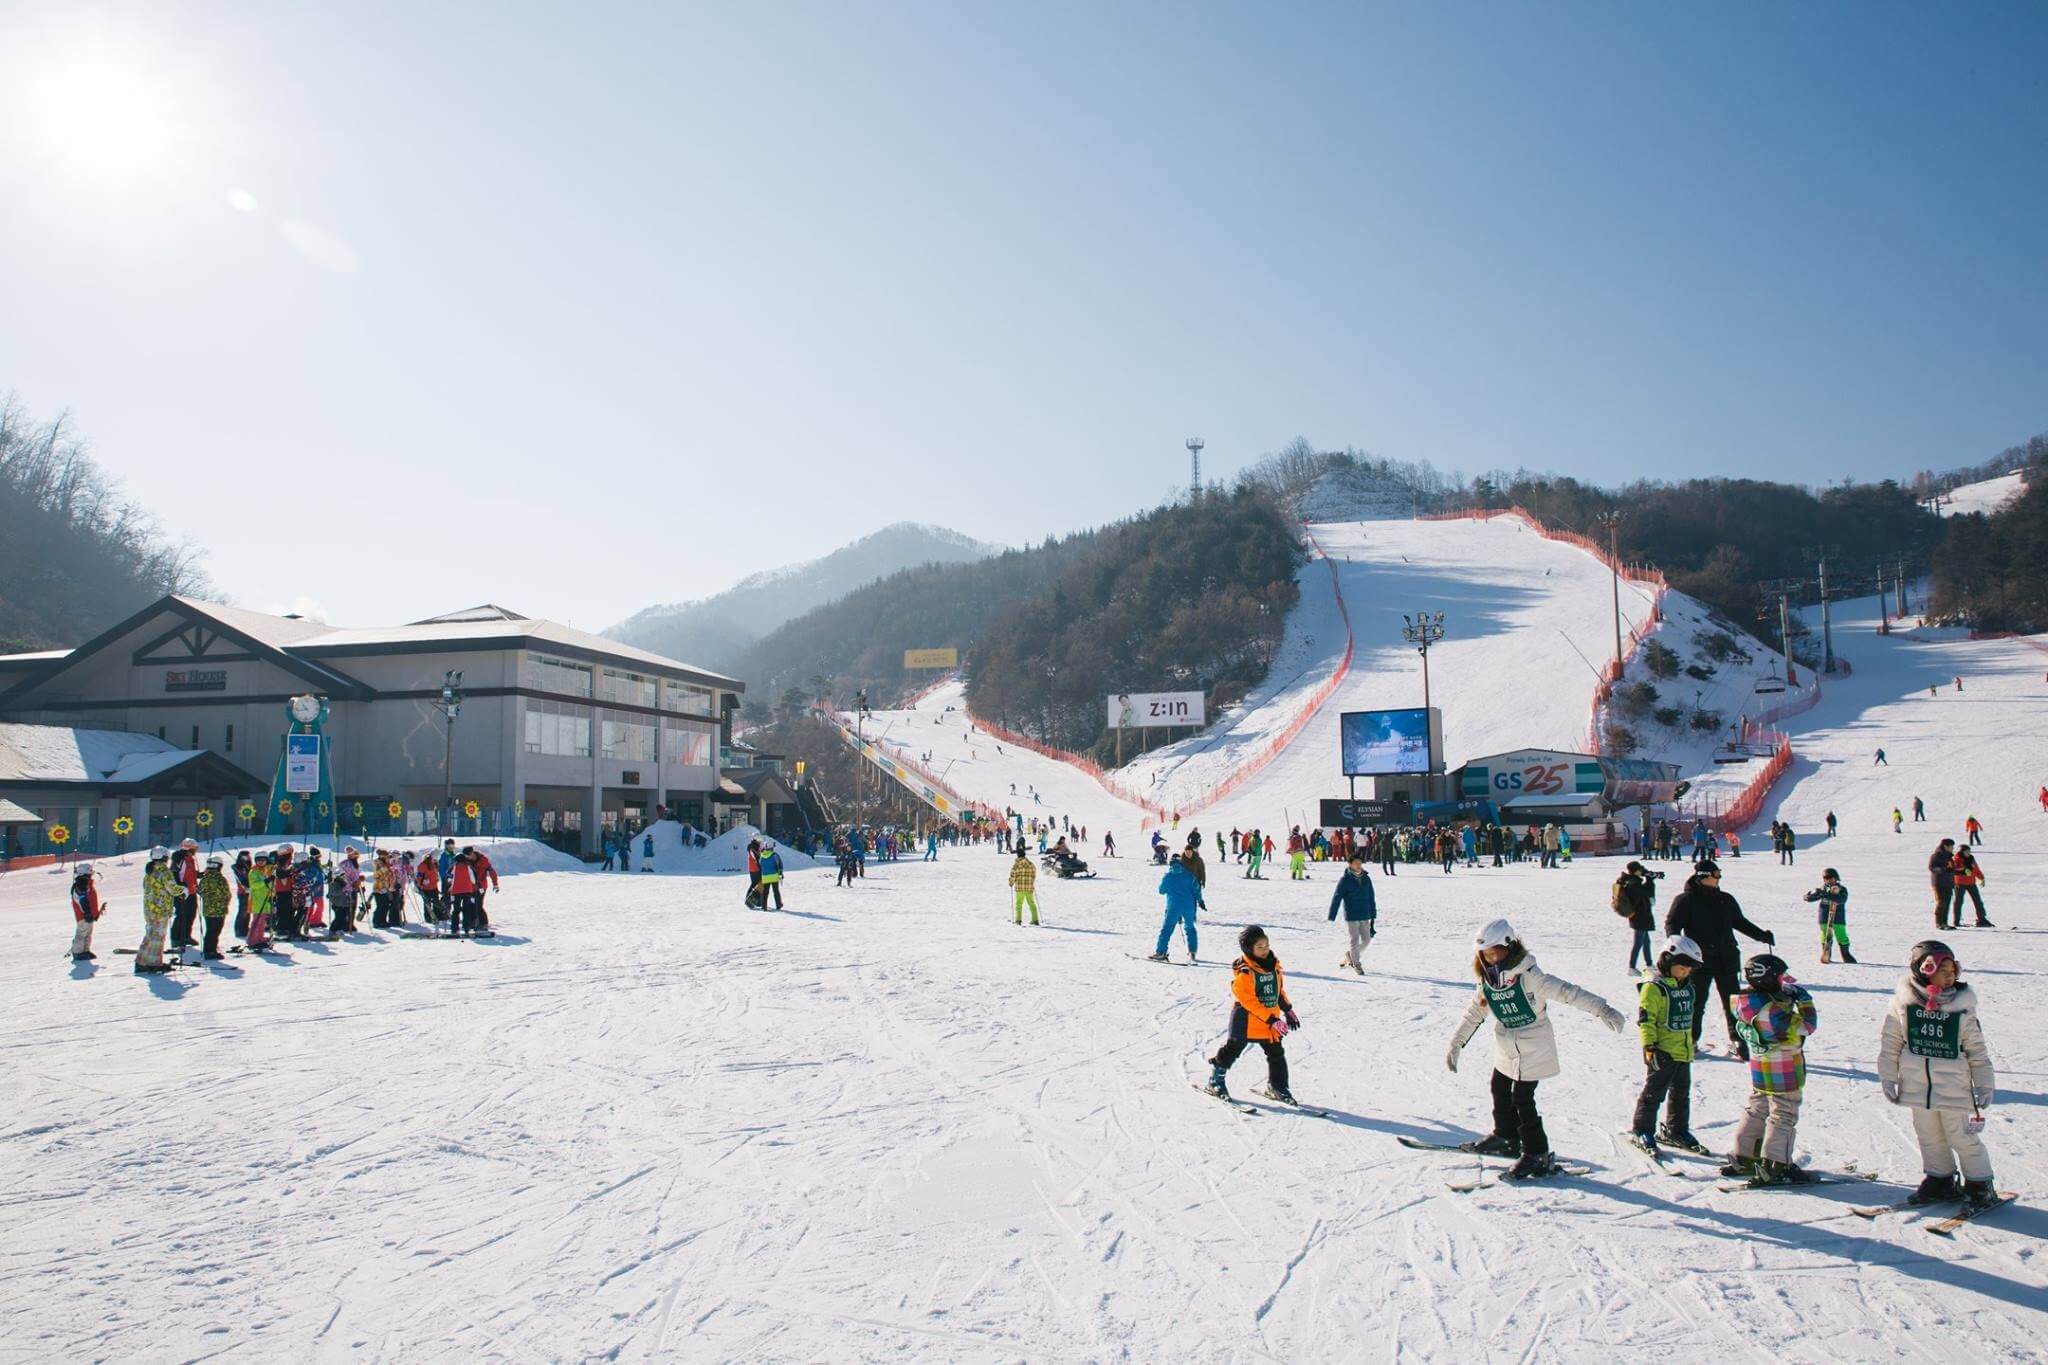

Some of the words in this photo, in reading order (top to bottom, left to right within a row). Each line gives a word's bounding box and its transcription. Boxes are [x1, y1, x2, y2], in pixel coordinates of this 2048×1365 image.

[1494, 763, 1569, 795] GS25
[1491, 990, 1515, 1000] GROUP
[1500, 1002, 1519, 1014] 308
[1916, 1009, 1950, 1020] GROUP
[1920, 1023, 1944, 1038] 496
